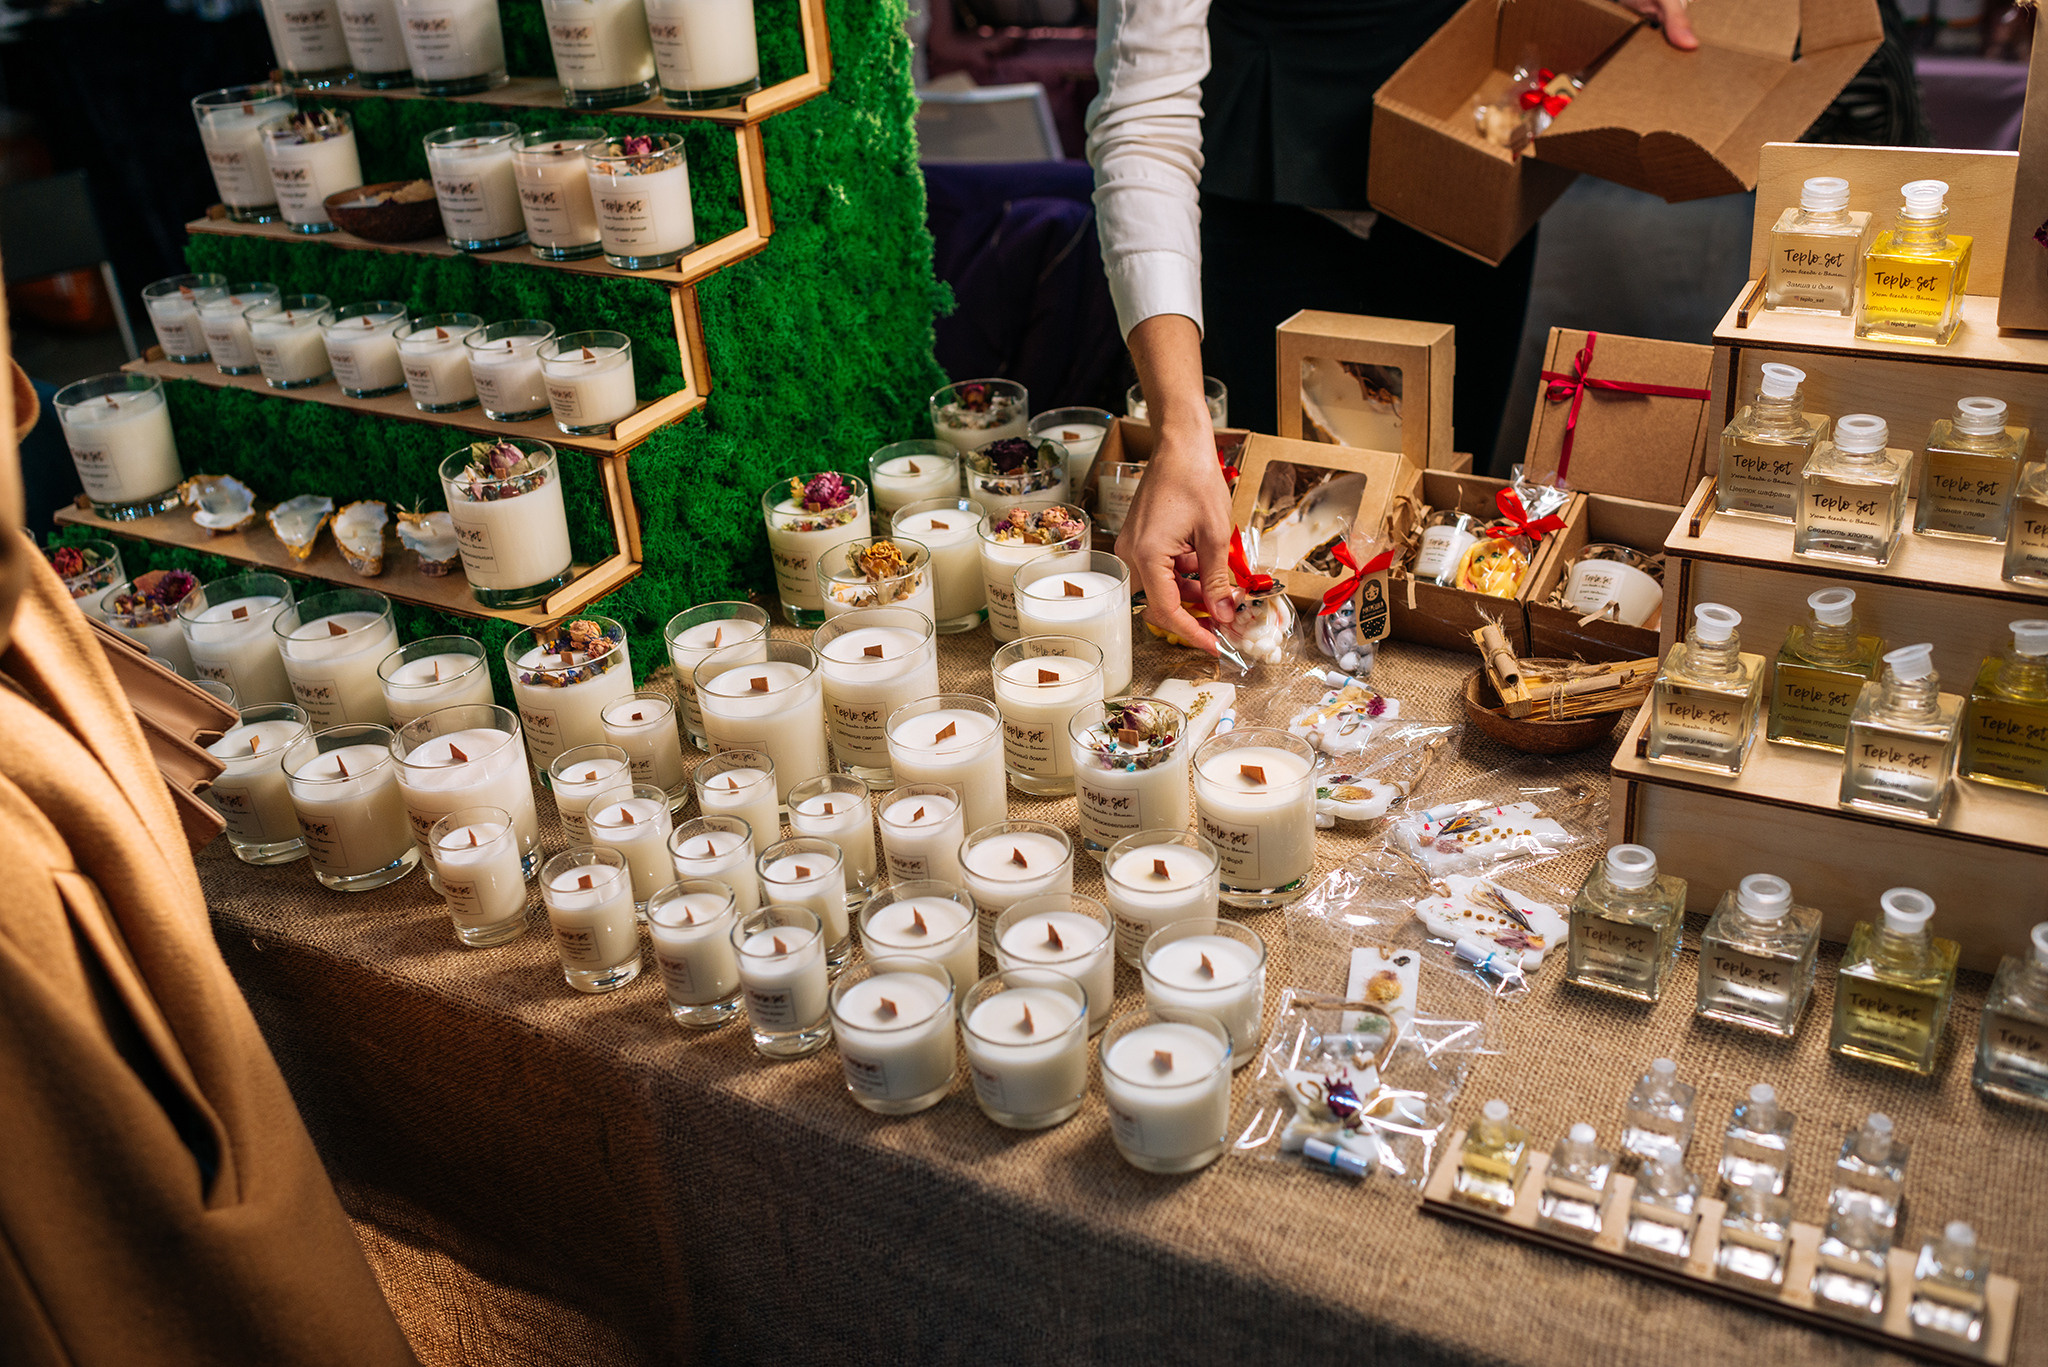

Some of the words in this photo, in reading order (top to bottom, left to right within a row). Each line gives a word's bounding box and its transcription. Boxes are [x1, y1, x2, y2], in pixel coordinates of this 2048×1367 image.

[1783, 249, 1845, 268] Teplo_set
[1786, 281, 1810, 290] Замша
[1818, 282, 1833, 290] дым
[1874, 272, 1938, 292] Teplo_set
[1862, 303, 1898, 313] Цитадель
[1900, 306, 1942, 317] Мейстеров
[1733, 455, 1793, 475] Teplo_set
[1729, 485, 1755, 495] Цветок
[1757, 489, 1791, 500] шафрана
[1811, 494, 1877, 516] Teplo_set
[1963, 510, 1985, 518] слива
[1807, 525, 1845, 536] Свежесть
[1847, 530, 1874, 541] хлопка
[1829, 543, 1857, 552] teplo_set
[1785, 684, 1850, 707] Teplo_set
[1666, 702, 1730, 725] Teplo_set
[1667, 733, 1690, 743] Вечер
[1696, 738, 1724, 748] камина
[1226, 857, 1243, 866] Форд
